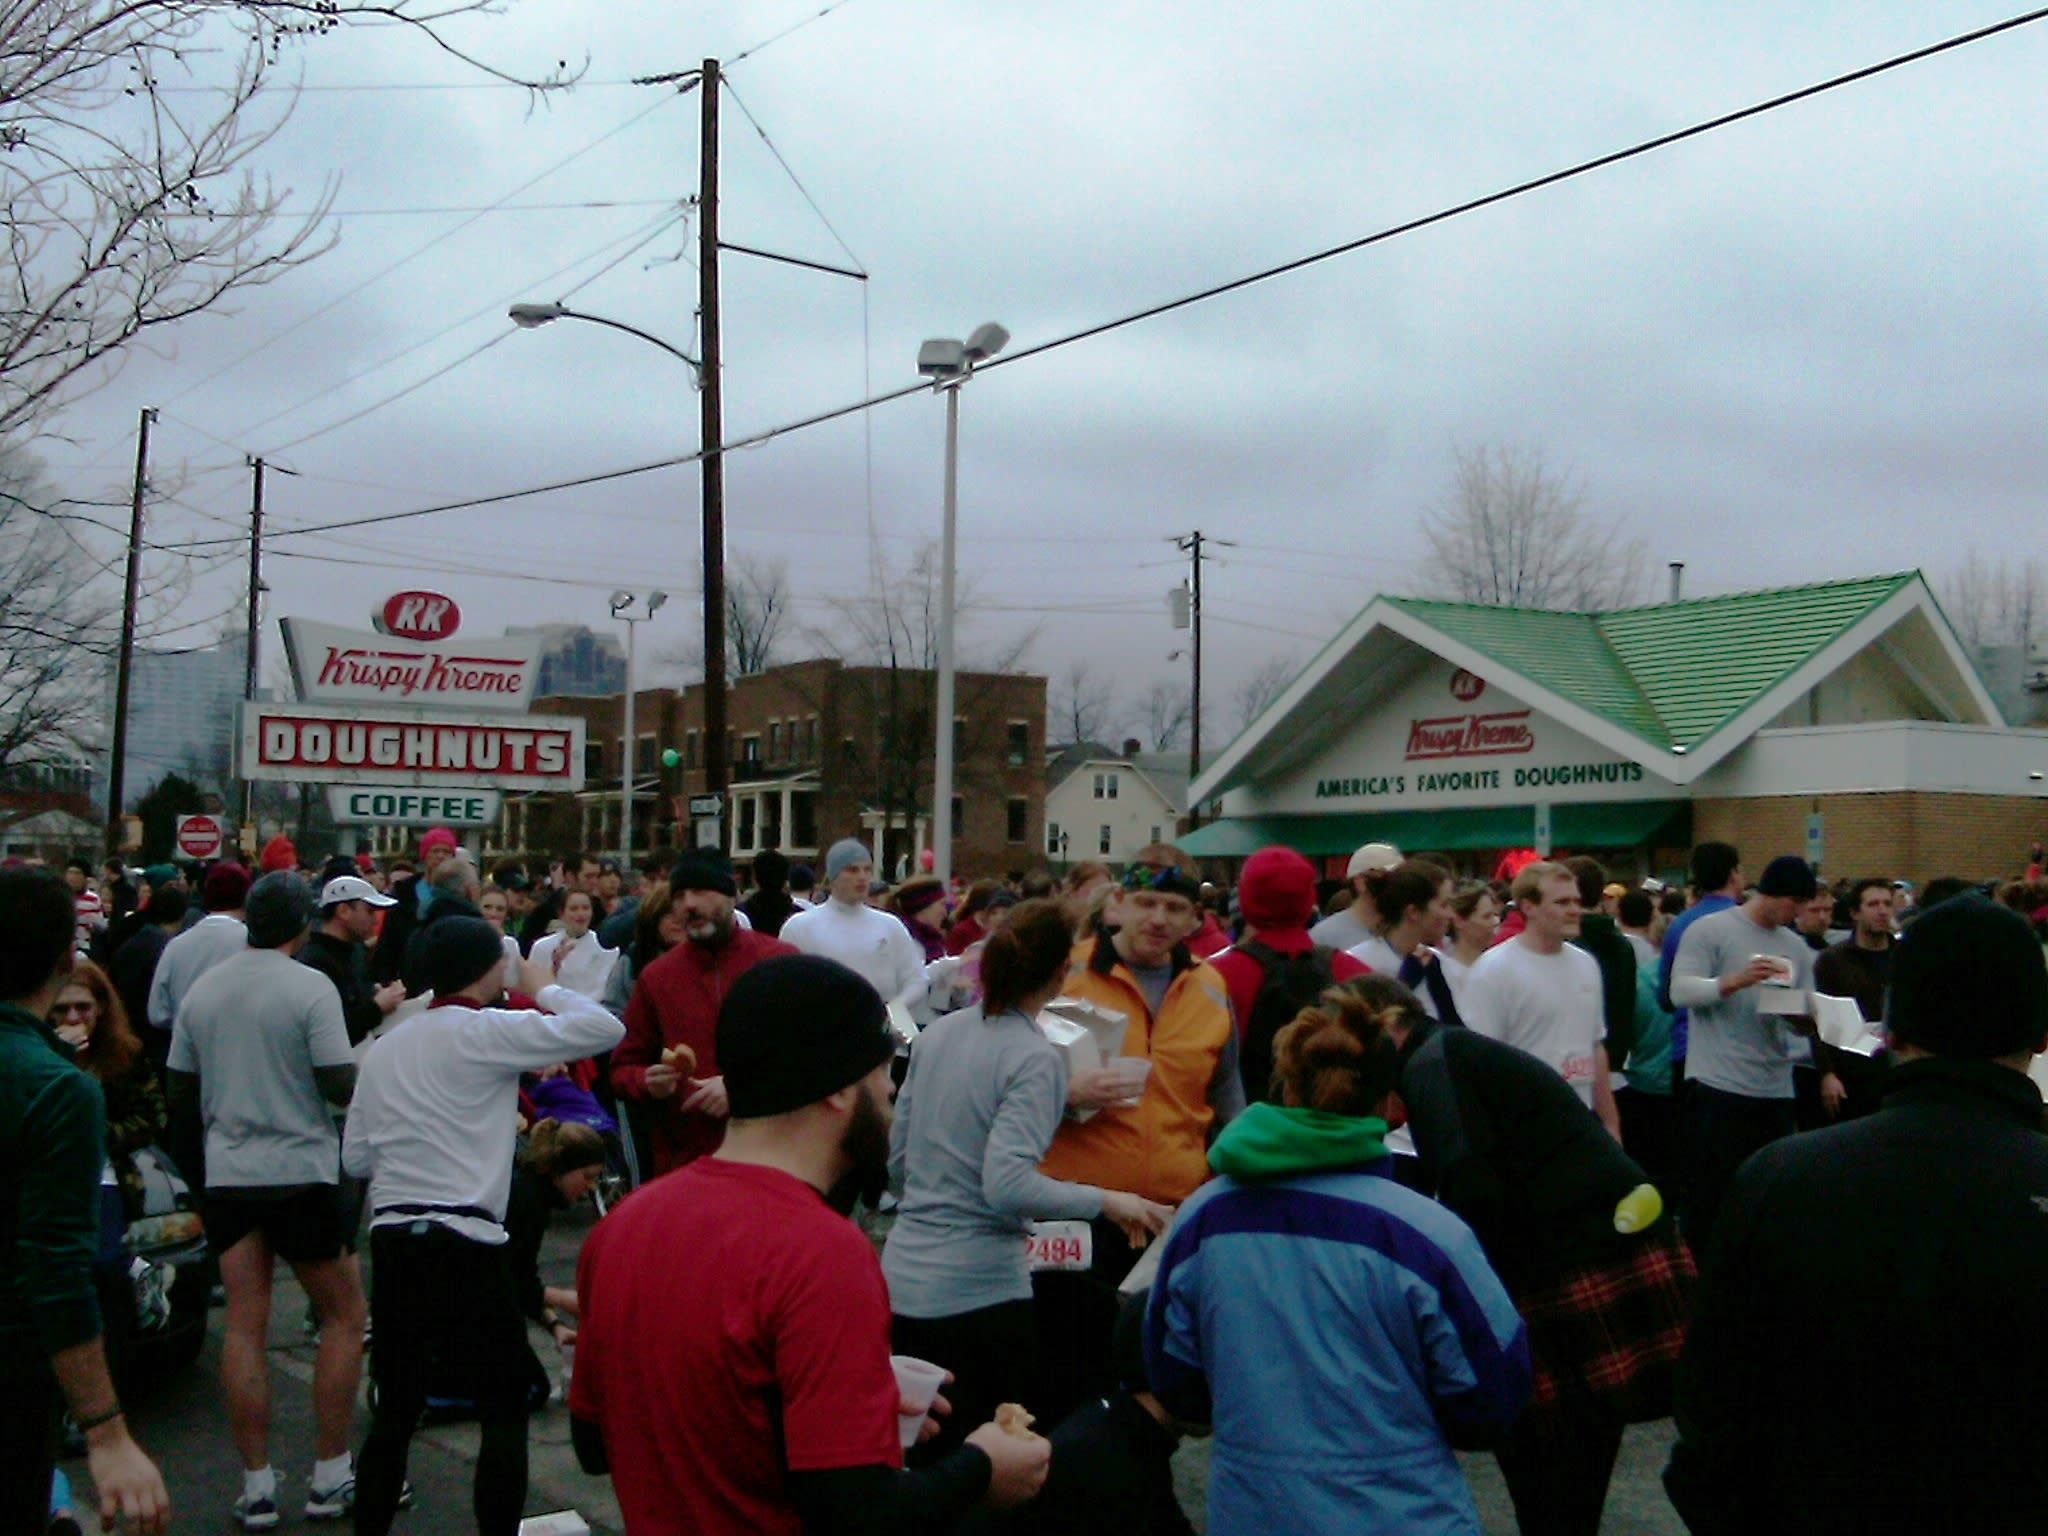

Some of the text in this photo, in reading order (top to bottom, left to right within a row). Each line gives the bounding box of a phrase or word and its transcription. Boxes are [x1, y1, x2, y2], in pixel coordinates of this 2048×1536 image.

[395, 597, 451, 632] KK
[318, 647, 527, 696] Krispy Kreme
[265, 721, 566, 773] DOUGHNUTS
[1464, 710, 1535, 753] Kreme
[1315, 761, 1643, 798] AMERICA'S FAVORITE DOUGHNUTS
[350, 793, 484, 820] COFFEE
